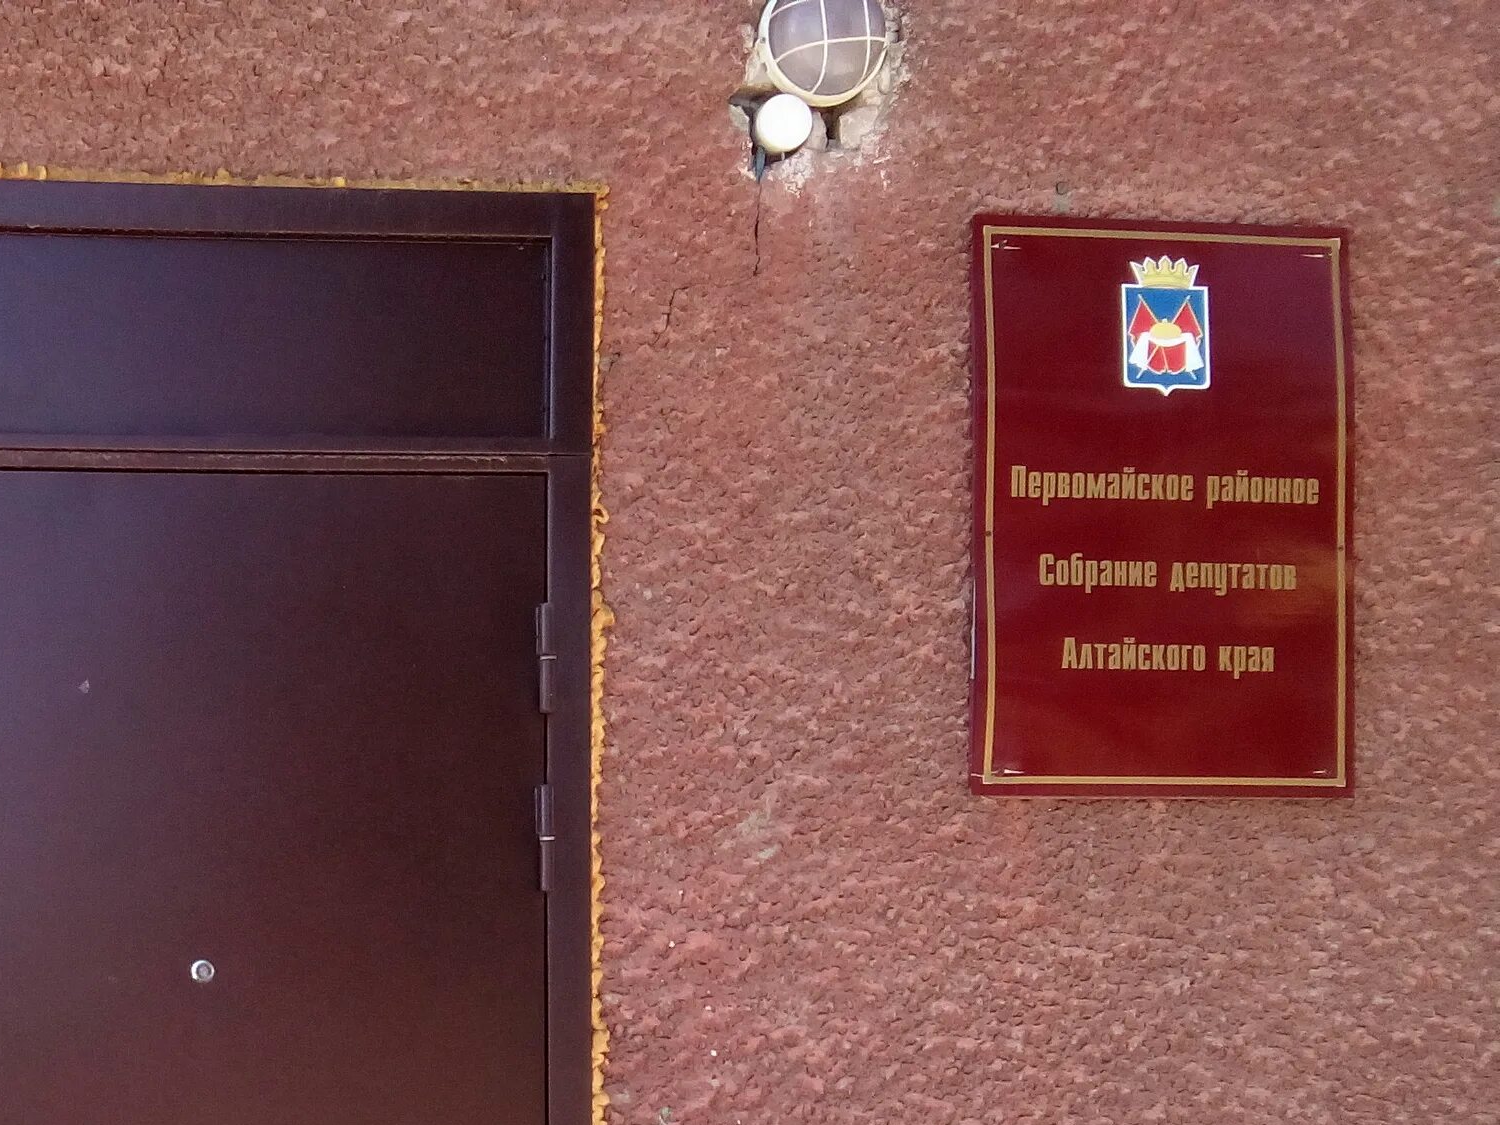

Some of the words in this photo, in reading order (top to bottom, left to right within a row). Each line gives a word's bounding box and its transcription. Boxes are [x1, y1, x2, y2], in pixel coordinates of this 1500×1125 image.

[1011, 465, 1194, 506] Первомайское
[1206, 469, 1320, 509] районное
[1039, 552, 1157, 594] Собрание
[1169, 561, 1297, 596] депутатов
[1061, 637, 1206, 671] Алтайского
[1218, 644, 1275, 680] края
